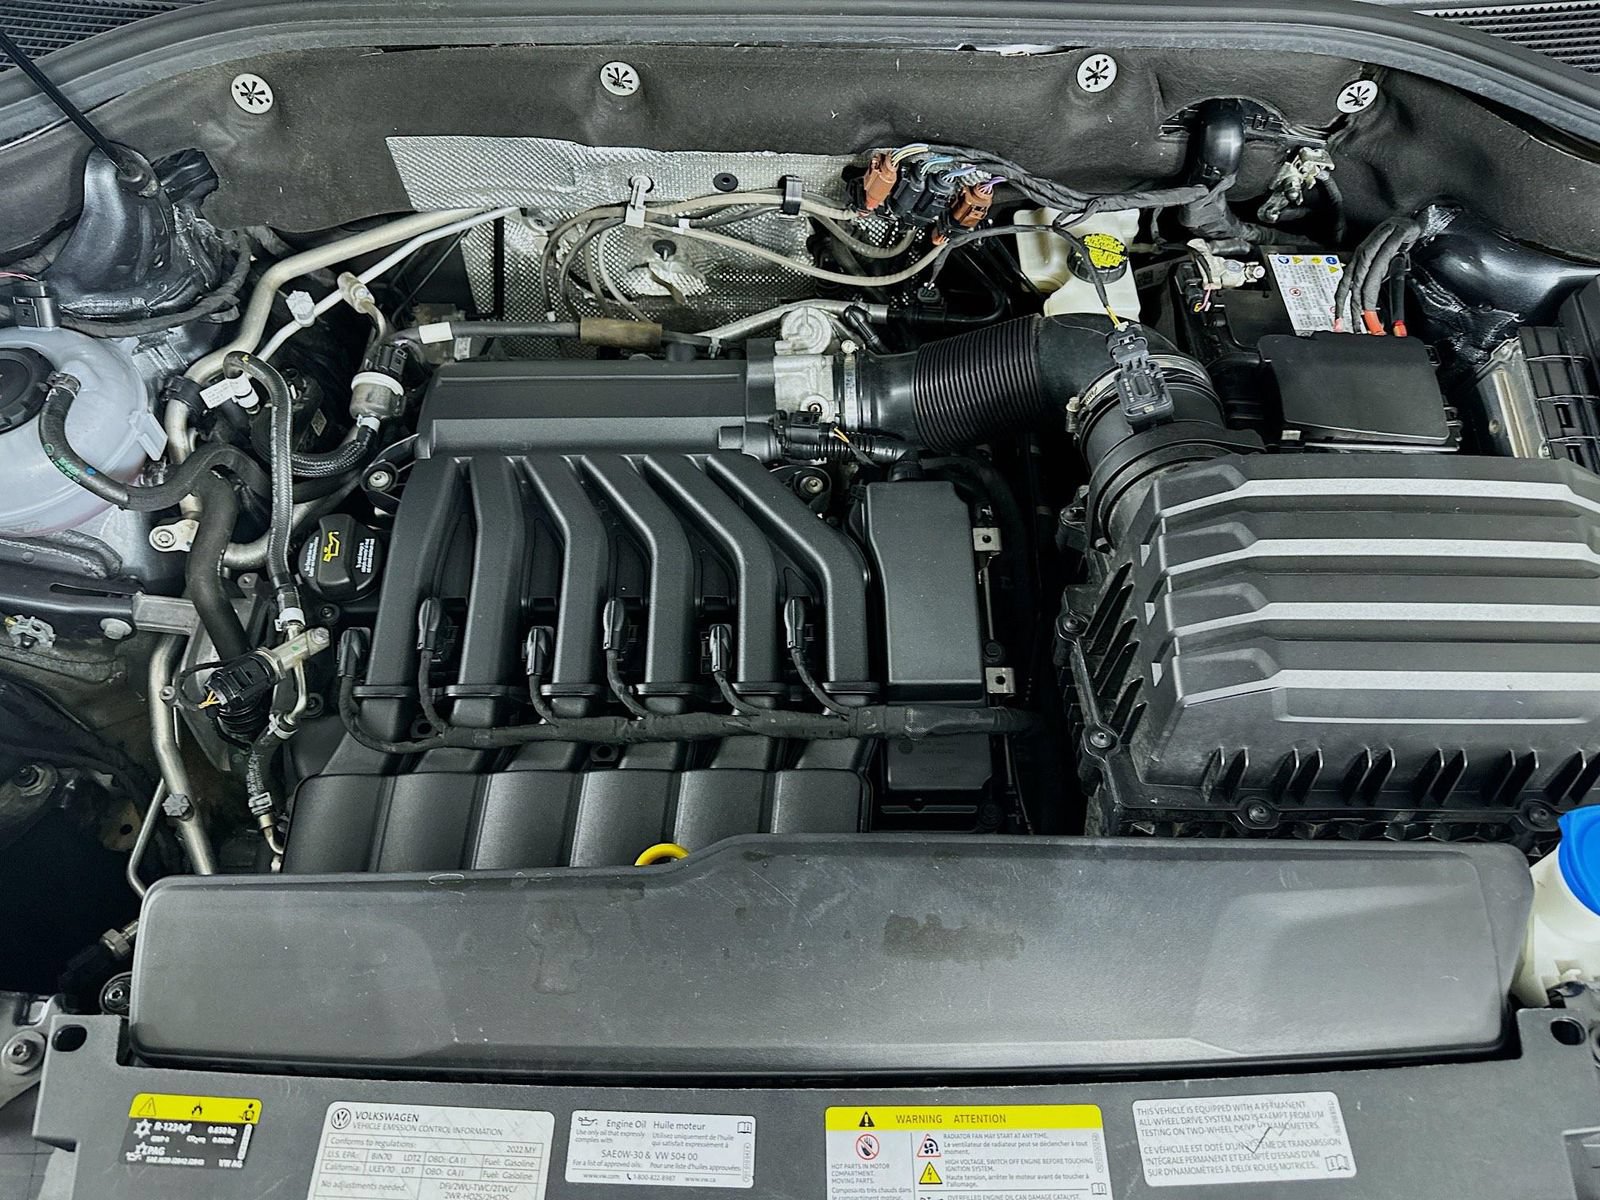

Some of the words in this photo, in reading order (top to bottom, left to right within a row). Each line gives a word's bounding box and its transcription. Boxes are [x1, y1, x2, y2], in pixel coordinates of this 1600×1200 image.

[1136, 1107, 1154, 1116] THIS
[1154, 1106, 1185, 1115] VEHICLE
[1186, 1105, 1194, 1114] IS
[1194, 1104, 1232, 1114] EQUIPPED
[1232, 1103, 1253, 1112] WITH
[354, 1111, 420, 1122] VOLKSWAGEN
[896, 1114, 943, 1124] WARNING
[953, 1114, 1006, 1124] ATTENTION
[1181, 1116, 1203, 1125] DRIVE
[1204, 1114, 1232, 1123] SYSTEM
[353, 1122, 381, 1131] VEHICLE
[383, 1123, 417, 1132] EMISSION
[418, 1124, 451, 1134] CONTROL
[453, 1127, 503, 1136] INFORMATION
[606, 1119, 634, 1130] Engine
[634, 1120, 647, 1129] Oil
[653, 1120, 675, 1130] Huile
[675, 1122, 706, 1131] moteur
[1140, 1128, 1172, 1137] TESTING
[1172, 1127, 1185, 1136] ON
[1186, 1125, 1234, 1135] TWO-WHEEL
[366, 1138, 373, 1146] to
[506, 1144, 524, 1153] 2022
[525, 1145, 537, 1154] MY
[1143, 1146, 1153, 1154] CE
[1190, 1144, 1203, 1153] EST
[644, 1150, 651, 1160] &
[654, 1151, 670, 1160] VW
[670, 1152, 686, 1160] 504
[687, 1152, 698, 1161] 00
[503, 1158, 536, 1168] Gasoline
[501, 1171, 534, 1180] Gasoline
